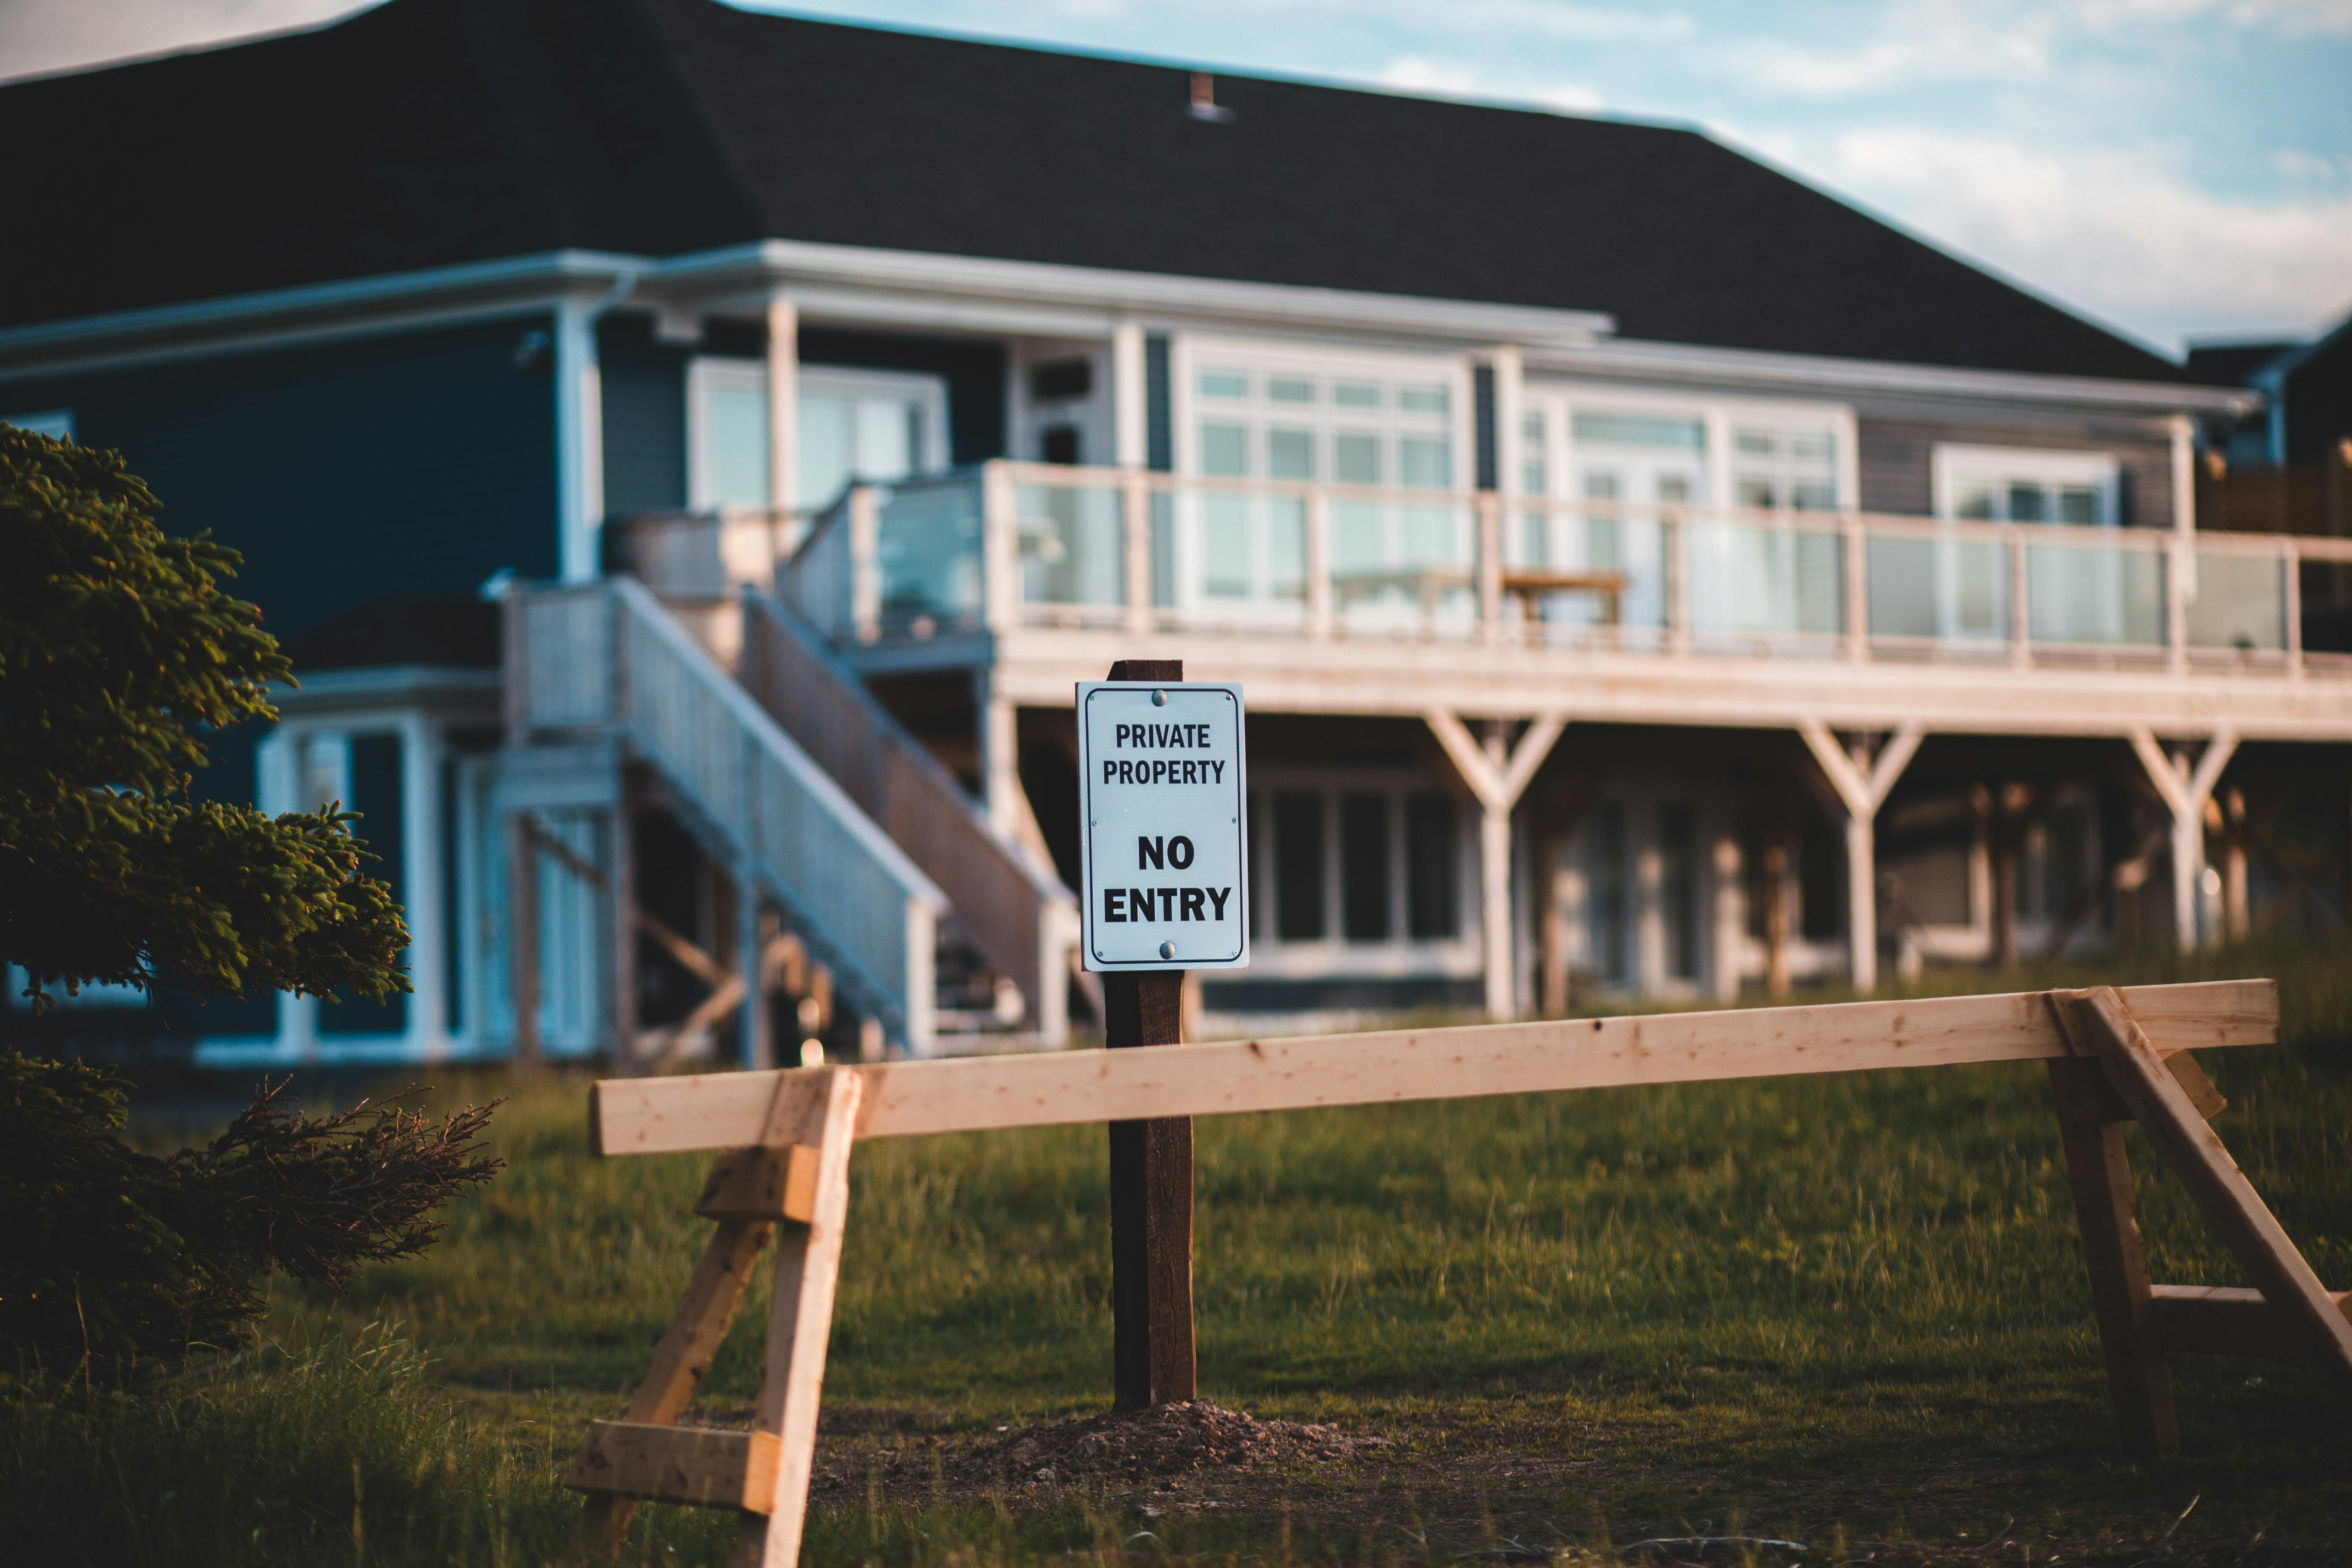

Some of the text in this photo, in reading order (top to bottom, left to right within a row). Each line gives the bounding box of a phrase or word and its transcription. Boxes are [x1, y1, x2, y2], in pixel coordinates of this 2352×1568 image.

[1116, 724, 1210, 748] PRIVATE
[1103, 760, 1225, 784] PROPERTY
[1138, 835, 1194, 870] NO
[1104, 887, 1231, 923] ENTRY
